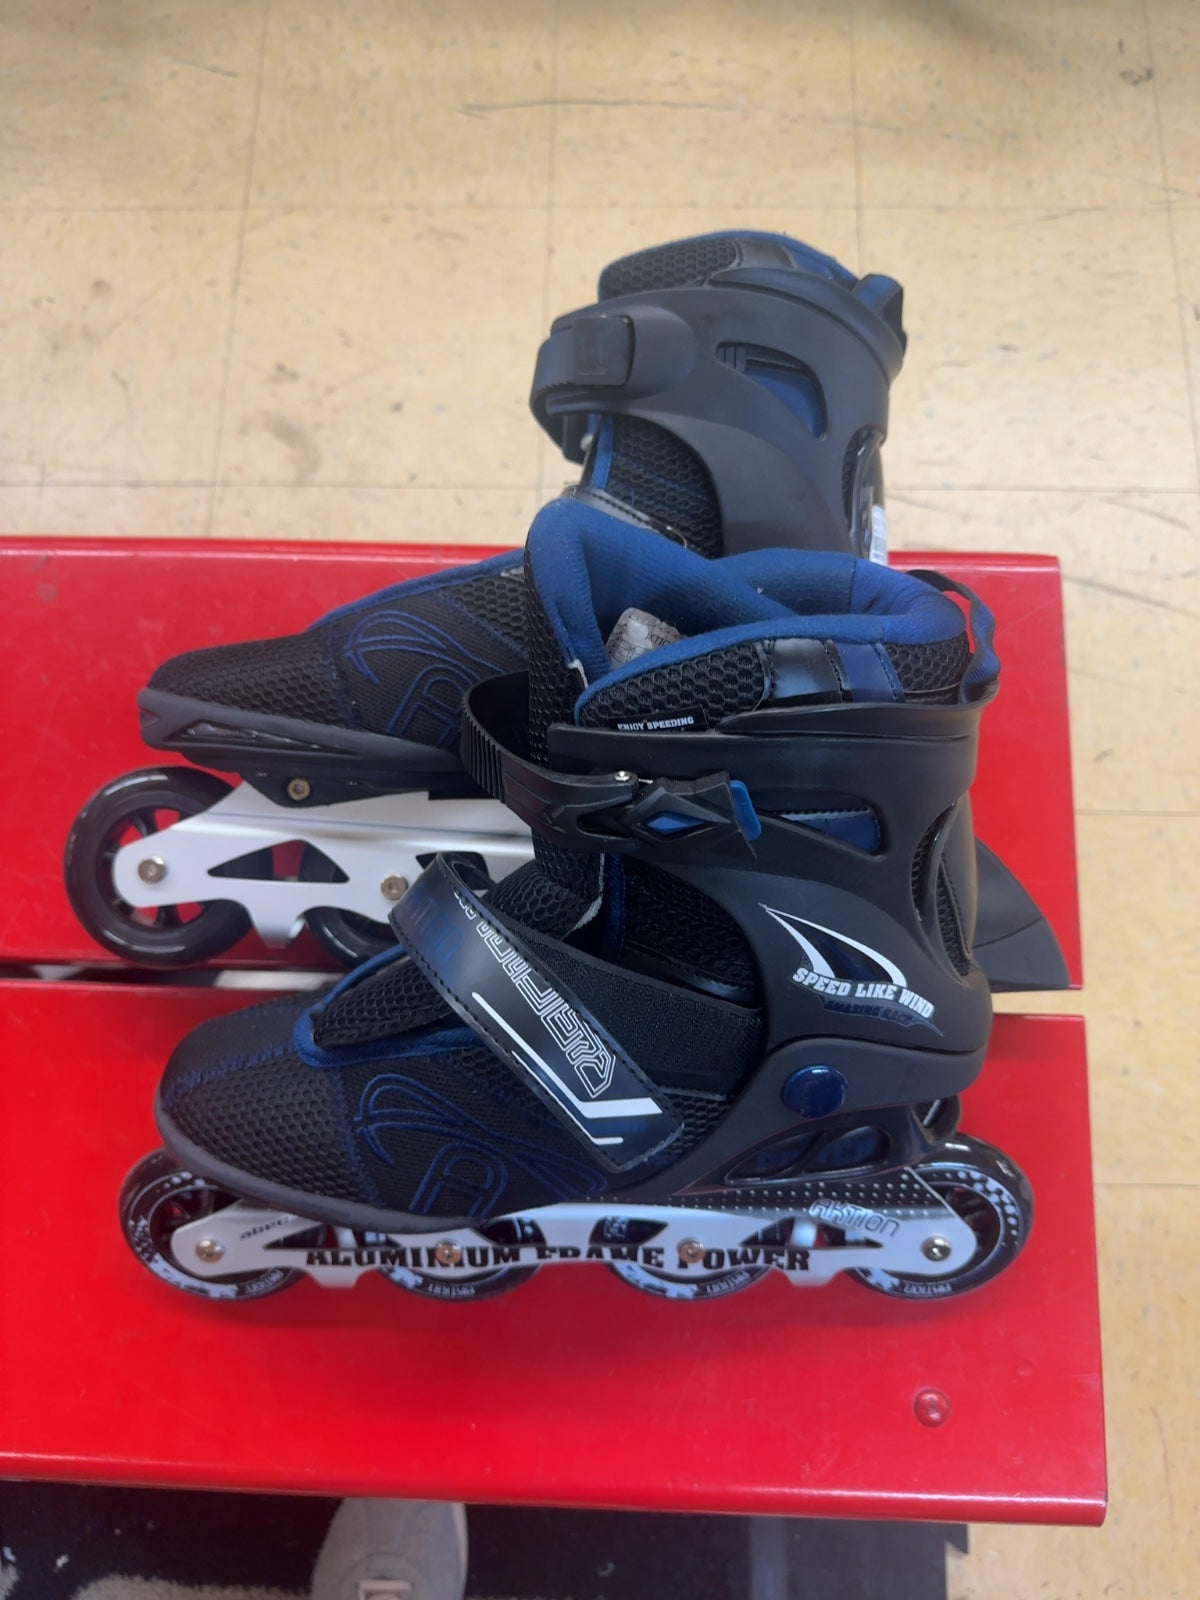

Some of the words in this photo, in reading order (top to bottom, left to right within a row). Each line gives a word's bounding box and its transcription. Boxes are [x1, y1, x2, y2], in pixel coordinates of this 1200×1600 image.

[617, 722, 644, 731] ENJOY
[647, 716, 694, 730] SPEEDING
[792, 967, 851, 997] SPEED
[854, 983, 898, 1001] LIKE
[898, 988, 935, 1019] WIND
[535, 1246, 665, 1269] FRAME
